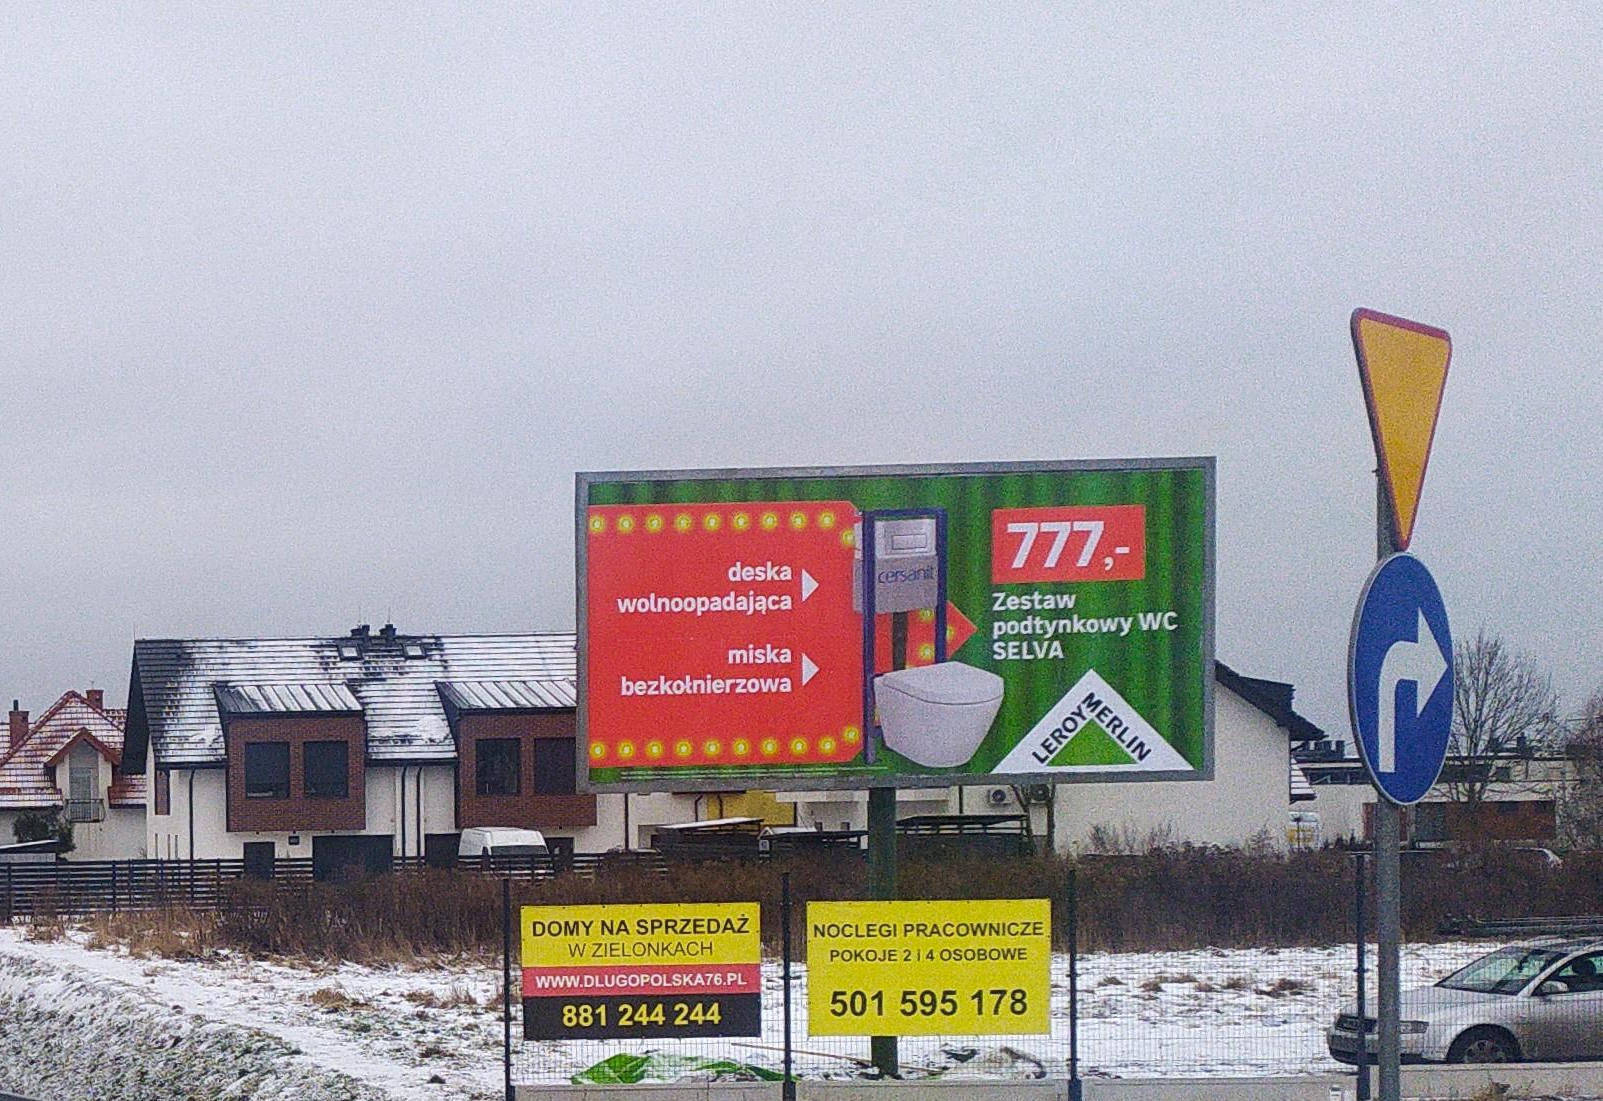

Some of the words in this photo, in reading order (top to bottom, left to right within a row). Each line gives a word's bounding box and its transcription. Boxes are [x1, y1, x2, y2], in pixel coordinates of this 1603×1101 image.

[728, 561, 792, 581] deska
[878, 565, 936, 584] cersanit
[617, 591, 792, 616] wolnoopadająca
[992, 591, 1076, 611] Zestaw
[993, 614, 1132, 639] podtynkowy
[1138, 612, 1178, 631] WC
[728, 644, 792, 664] miska
[992, 641, 1064, 660] SELVA
[621, 674, 792, 696] bezkołnierzowa
[1031, 705, 1087, 764] LEROY
[1082, 692, 1151, 761] MERLIN
[532, 921, 594, 937] DOMY
[601, 920, 630, 935] NA
[636, 914, 749, 935] SPRZEDAŻ
[814, 923, 897, 938] NOCLEGI
[904, 922, 1044, 937] PRACOWNICZE
[568, 944, 586, 957] W
[592, 941, 713, 957] ZIELONKACH
[830, 949, 898, 962] POKOJE
[903, 949, 912, 961] 2
[926, 949, 935, 961] 4
[940, 948, 1027, 961] OSOBOWE
[535, 973, 747, 988] WWW.DLUGOPOLSKA76.PL
[831, 990, 883, 1017] 501
[900, 990, 958, 1016] 595
[971, 989, 1027, 1015] 178
[563, 1004, 607, 1027] 881
[618, 1003, 666, 1025] 244
[674, 1003, 721, 1025] 244
